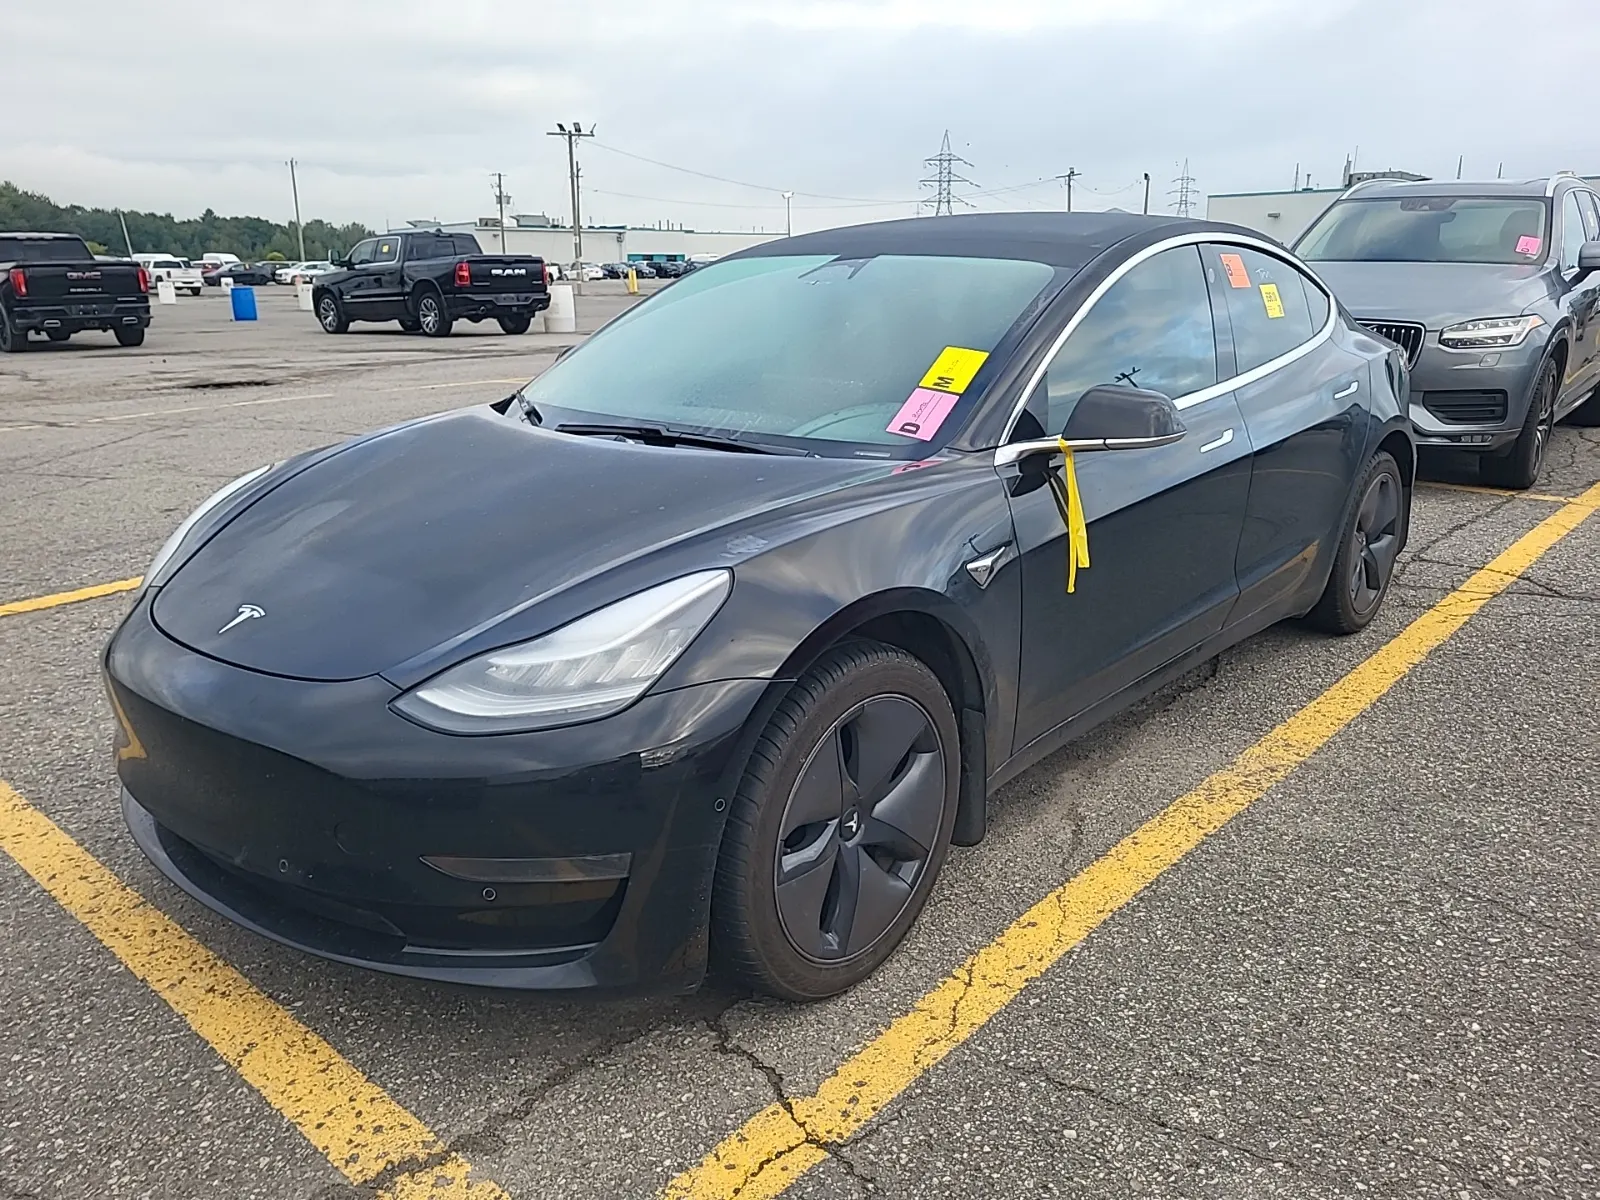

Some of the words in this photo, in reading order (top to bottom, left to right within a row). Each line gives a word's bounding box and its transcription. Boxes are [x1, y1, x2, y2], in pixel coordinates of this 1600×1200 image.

[66, 271, 102, 279] GMC
[932, 376, 955, 388] M
[898, 422, 920, 435] D
